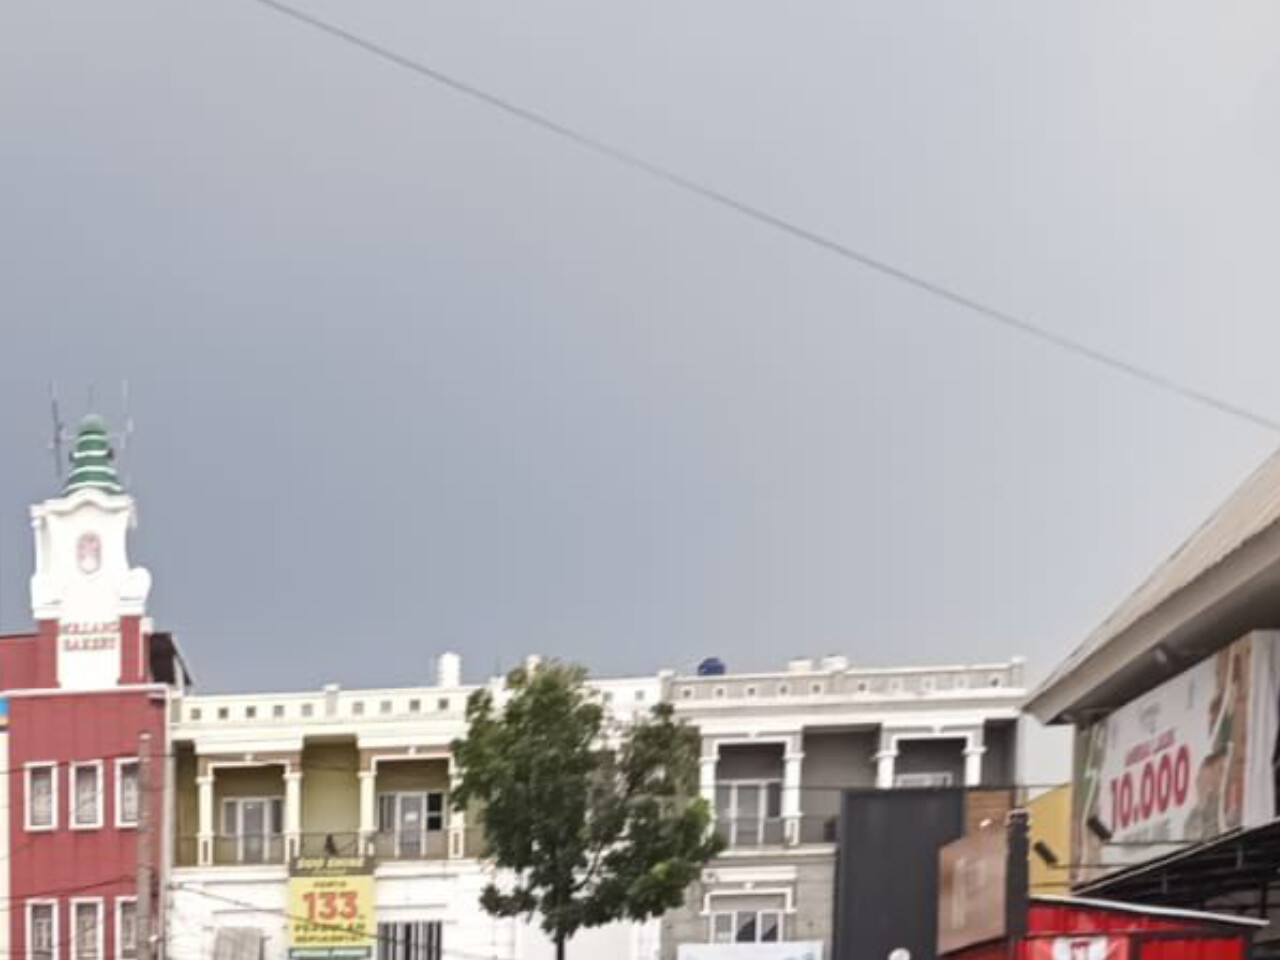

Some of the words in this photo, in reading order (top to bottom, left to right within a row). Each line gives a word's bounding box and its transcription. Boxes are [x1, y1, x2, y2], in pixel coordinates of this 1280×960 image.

[64, 636, 116, 652] BAKERY
[1110, 745, 1190, 834] 10.000
[303, 891, 358, 921] 133
